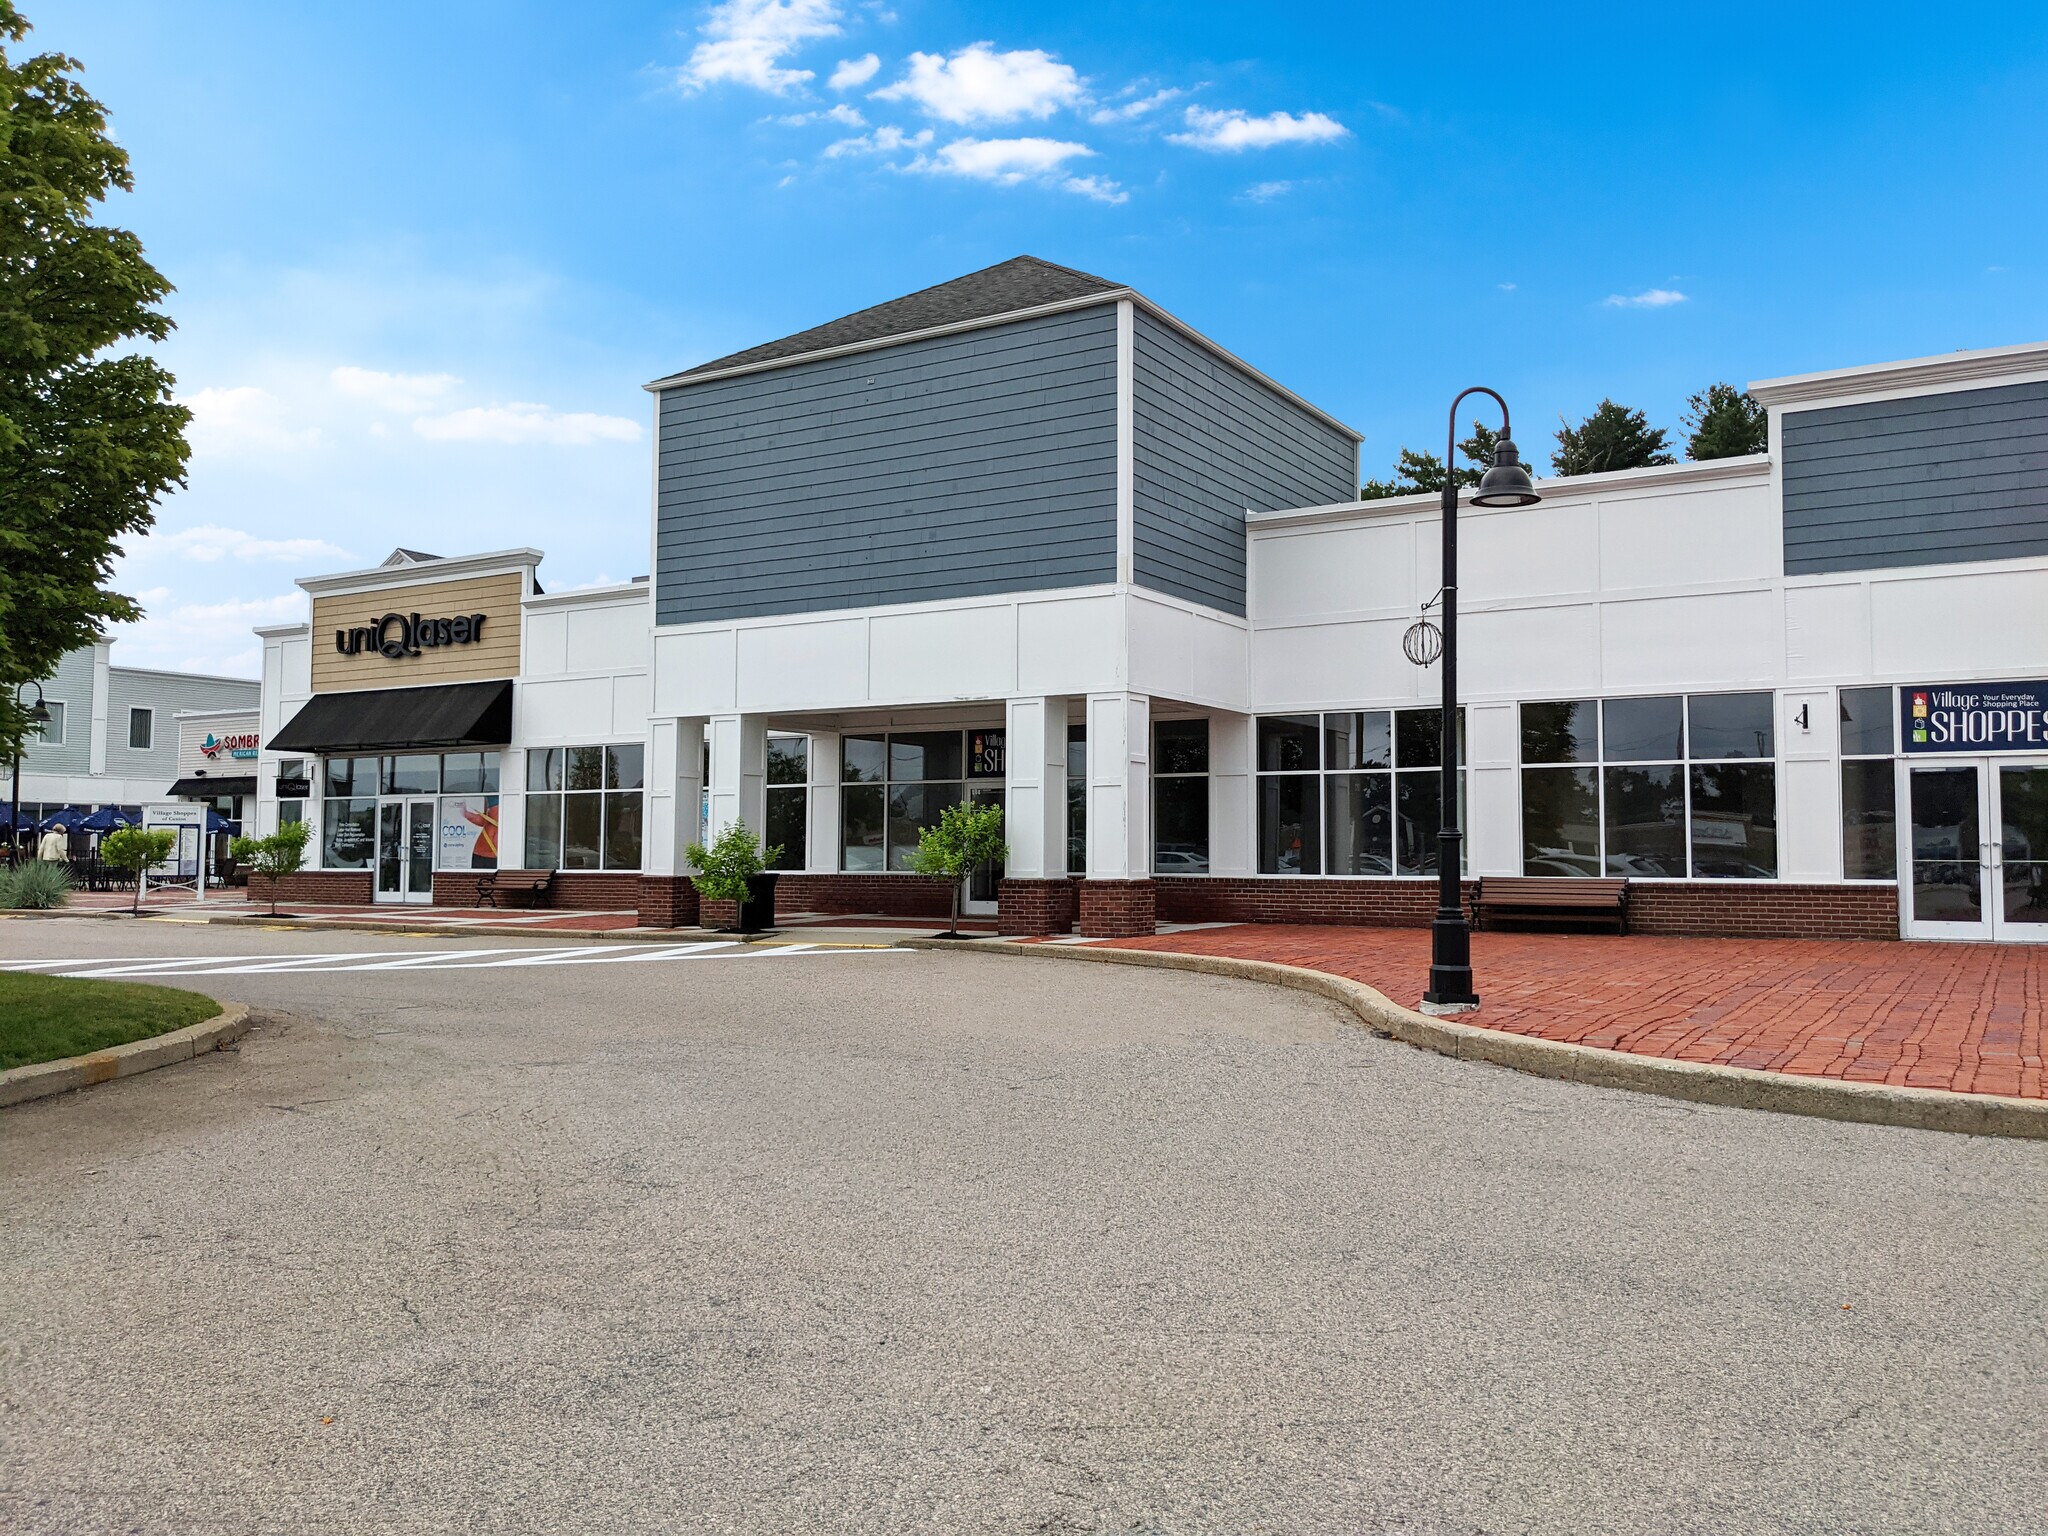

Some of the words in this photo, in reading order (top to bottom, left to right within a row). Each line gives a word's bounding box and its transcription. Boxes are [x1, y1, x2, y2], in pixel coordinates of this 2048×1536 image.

[336, 612, 487, 658] uniQlaser
[1931, 691, 1979, 711] Village
[2001, 693, 2035, 702] Everyday
[1982, 700, 2018, 708] Shopping
[442, 825, 466, 837] COOL
